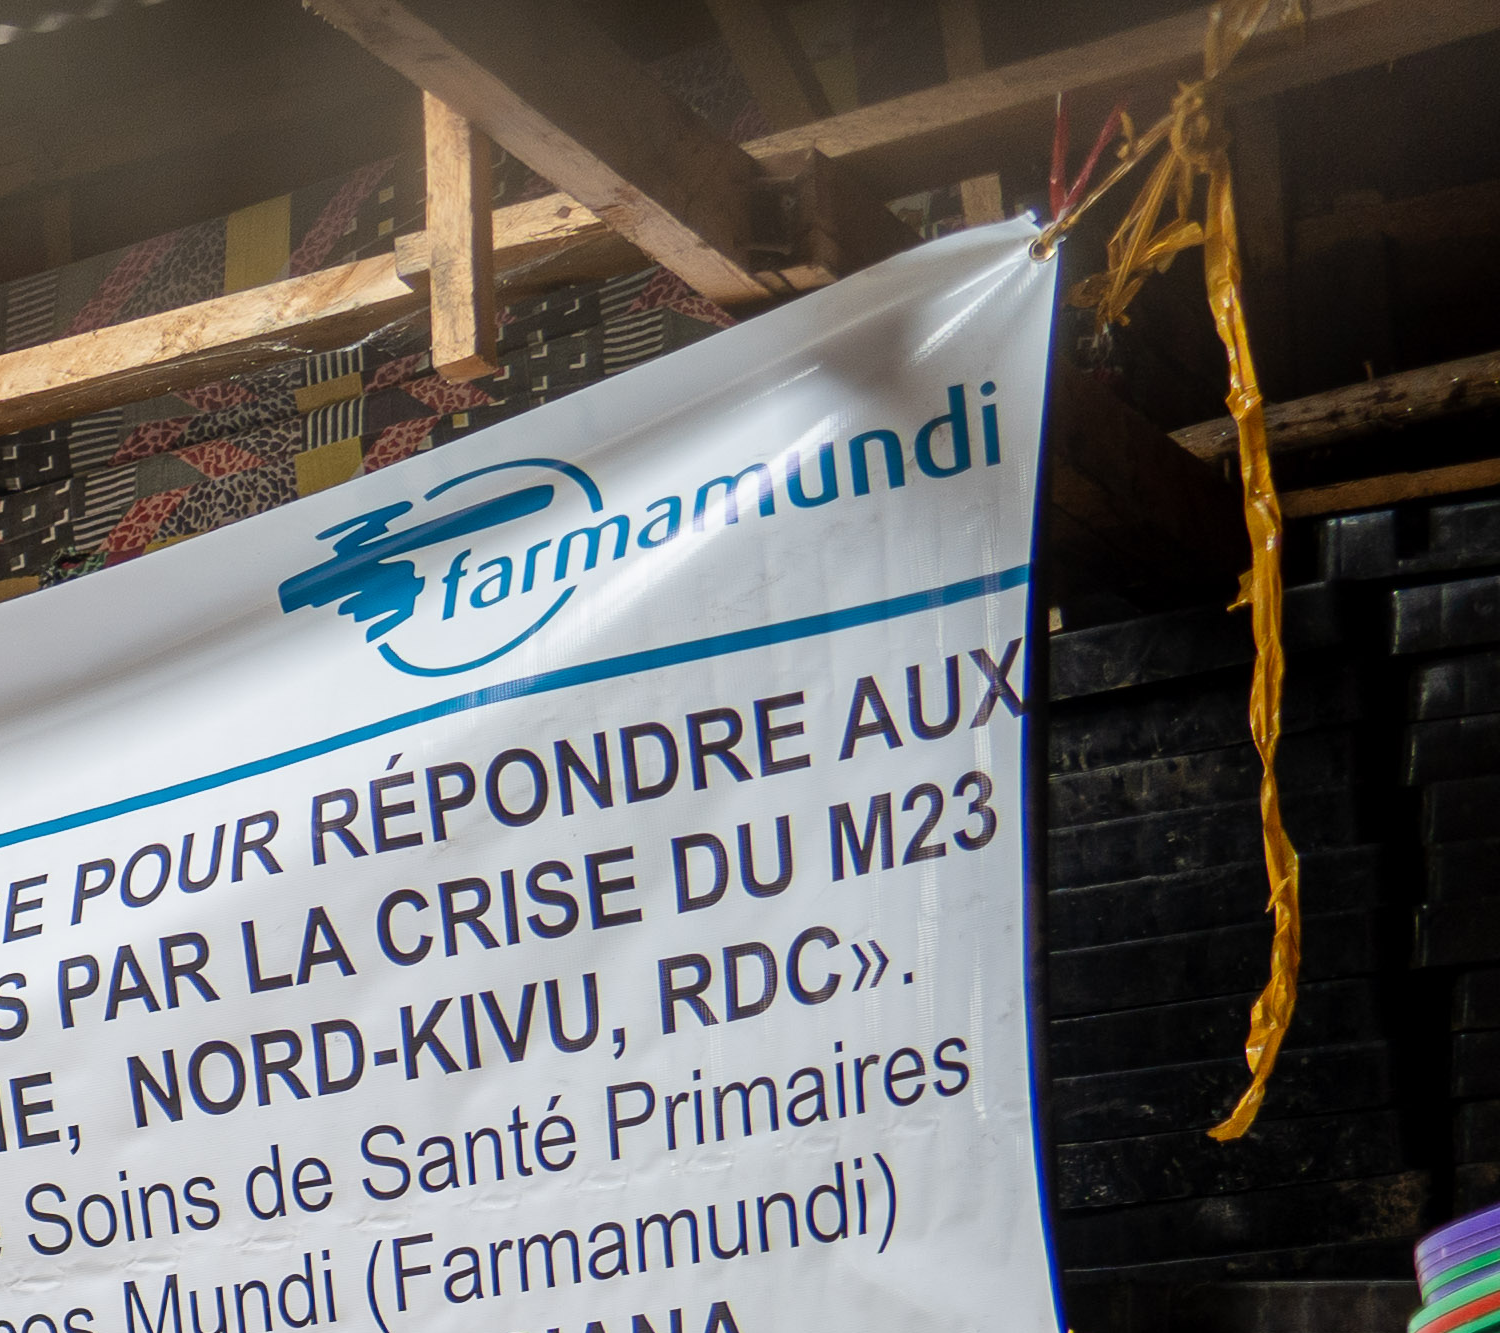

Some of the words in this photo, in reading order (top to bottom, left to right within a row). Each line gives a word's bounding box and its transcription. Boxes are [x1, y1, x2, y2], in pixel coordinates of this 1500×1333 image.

[441, 380, 1002, 621] farmamundi
[57, 931, 226, 1030] PAR
[243, 906, 357, 993] LA
[376, 846, 644, 967] CRISE
[671, 814, 794, 915] DU
[829, 770, 998, 881] M23
[71, 810, 282, 926] POUR
[311, 691, 810, 865] RÉPONDRE
[838, 637, 1024, 761] AUX
[27, 1171, 221, 1255] Soins
[246, 1145, 332, 1219] de
[362, 1095, 578, 1201] Santé
[606, 1037, 971, 1161] Primaires
[126, 972, 627, 1127] NORD-KIVU,
